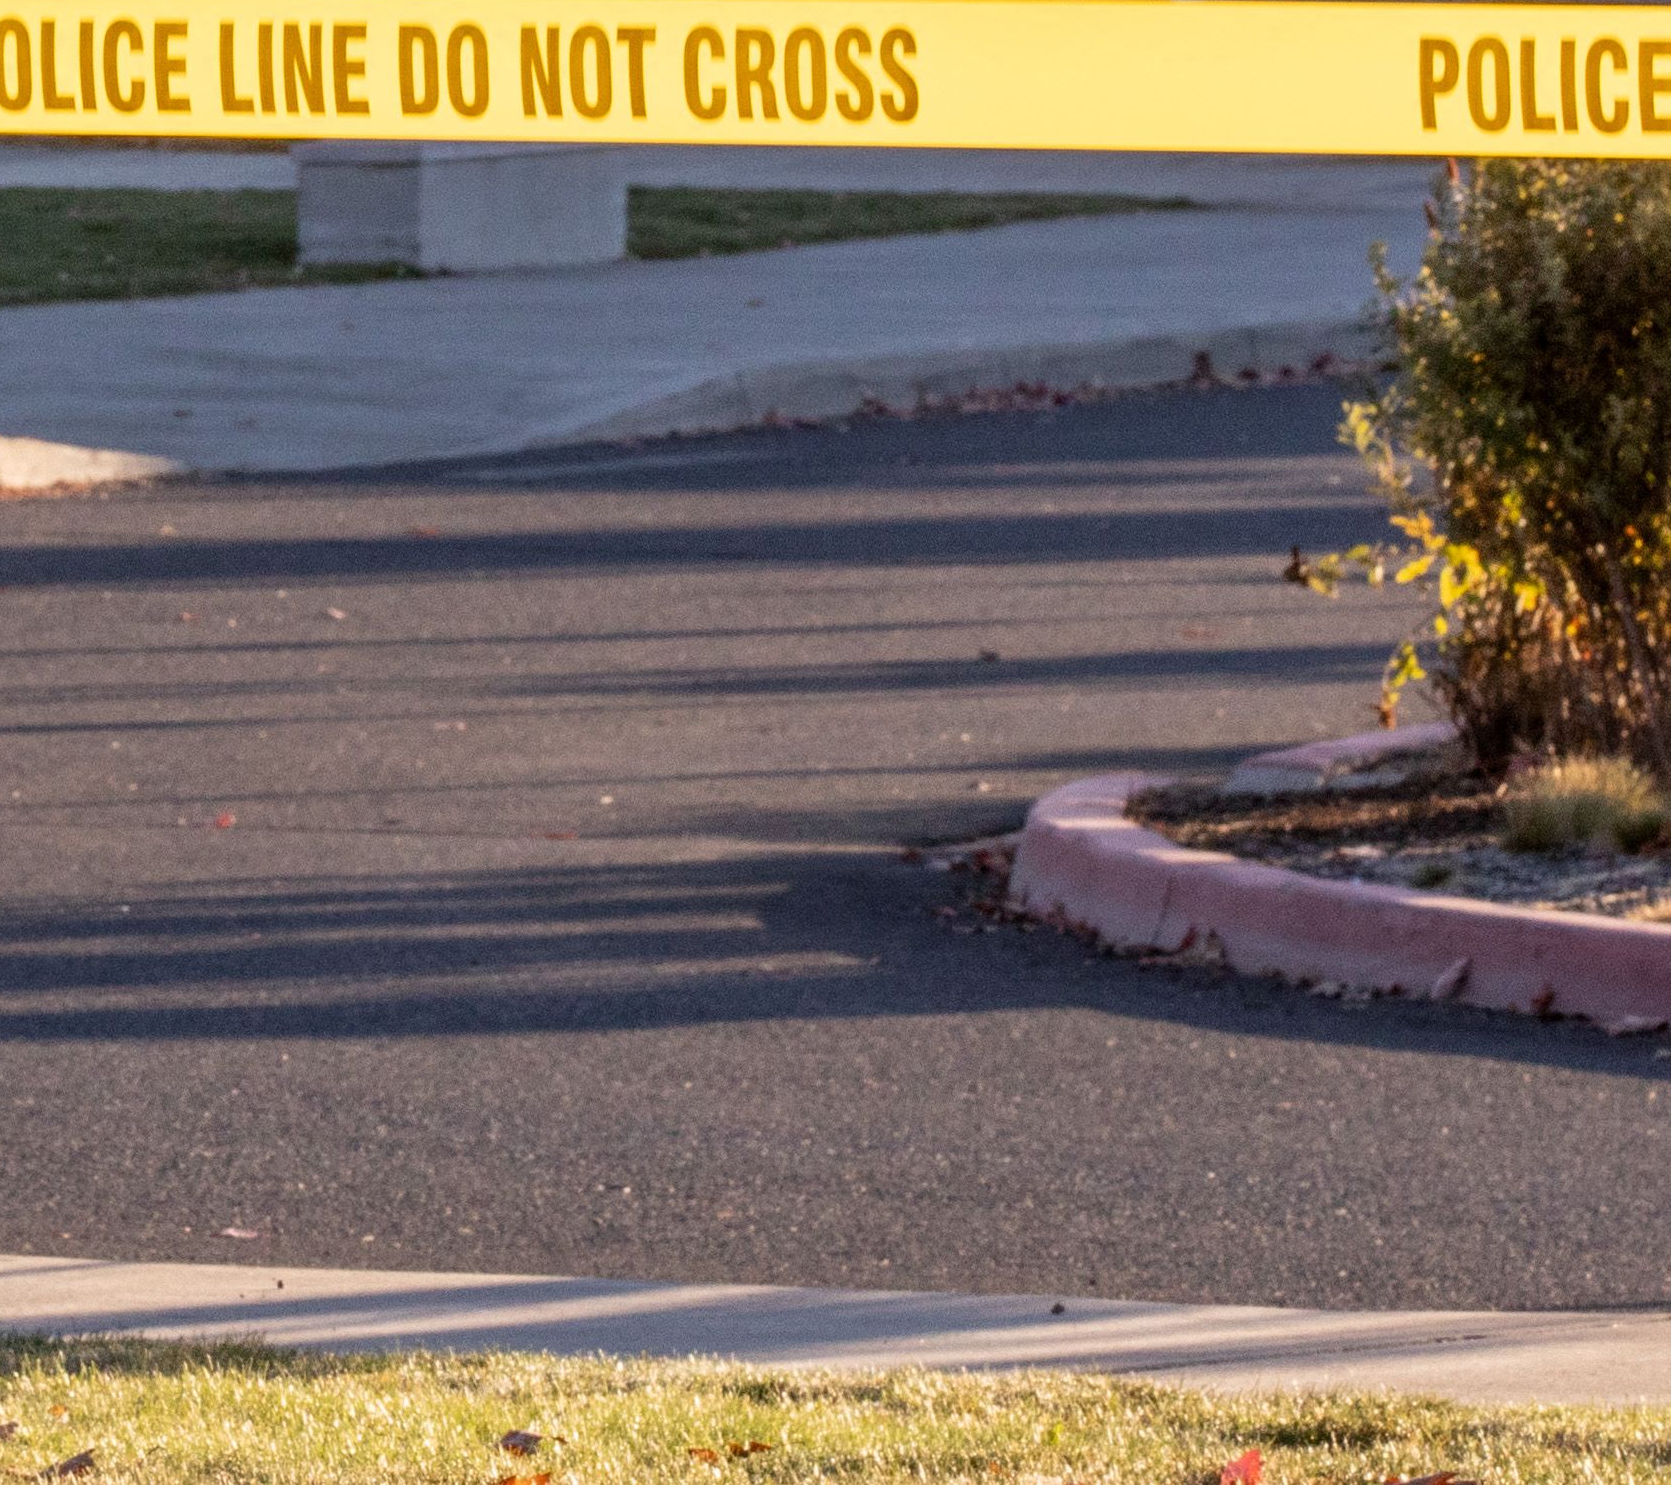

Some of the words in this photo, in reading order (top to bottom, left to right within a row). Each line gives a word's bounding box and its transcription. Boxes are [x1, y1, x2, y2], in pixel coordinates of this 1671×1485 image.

[220, 24, 369, 113] LINE
[399, 25, 489, 117] DO
[521, 26, 655, 118] NOT
[684, 27, 918, 121] CROSS
